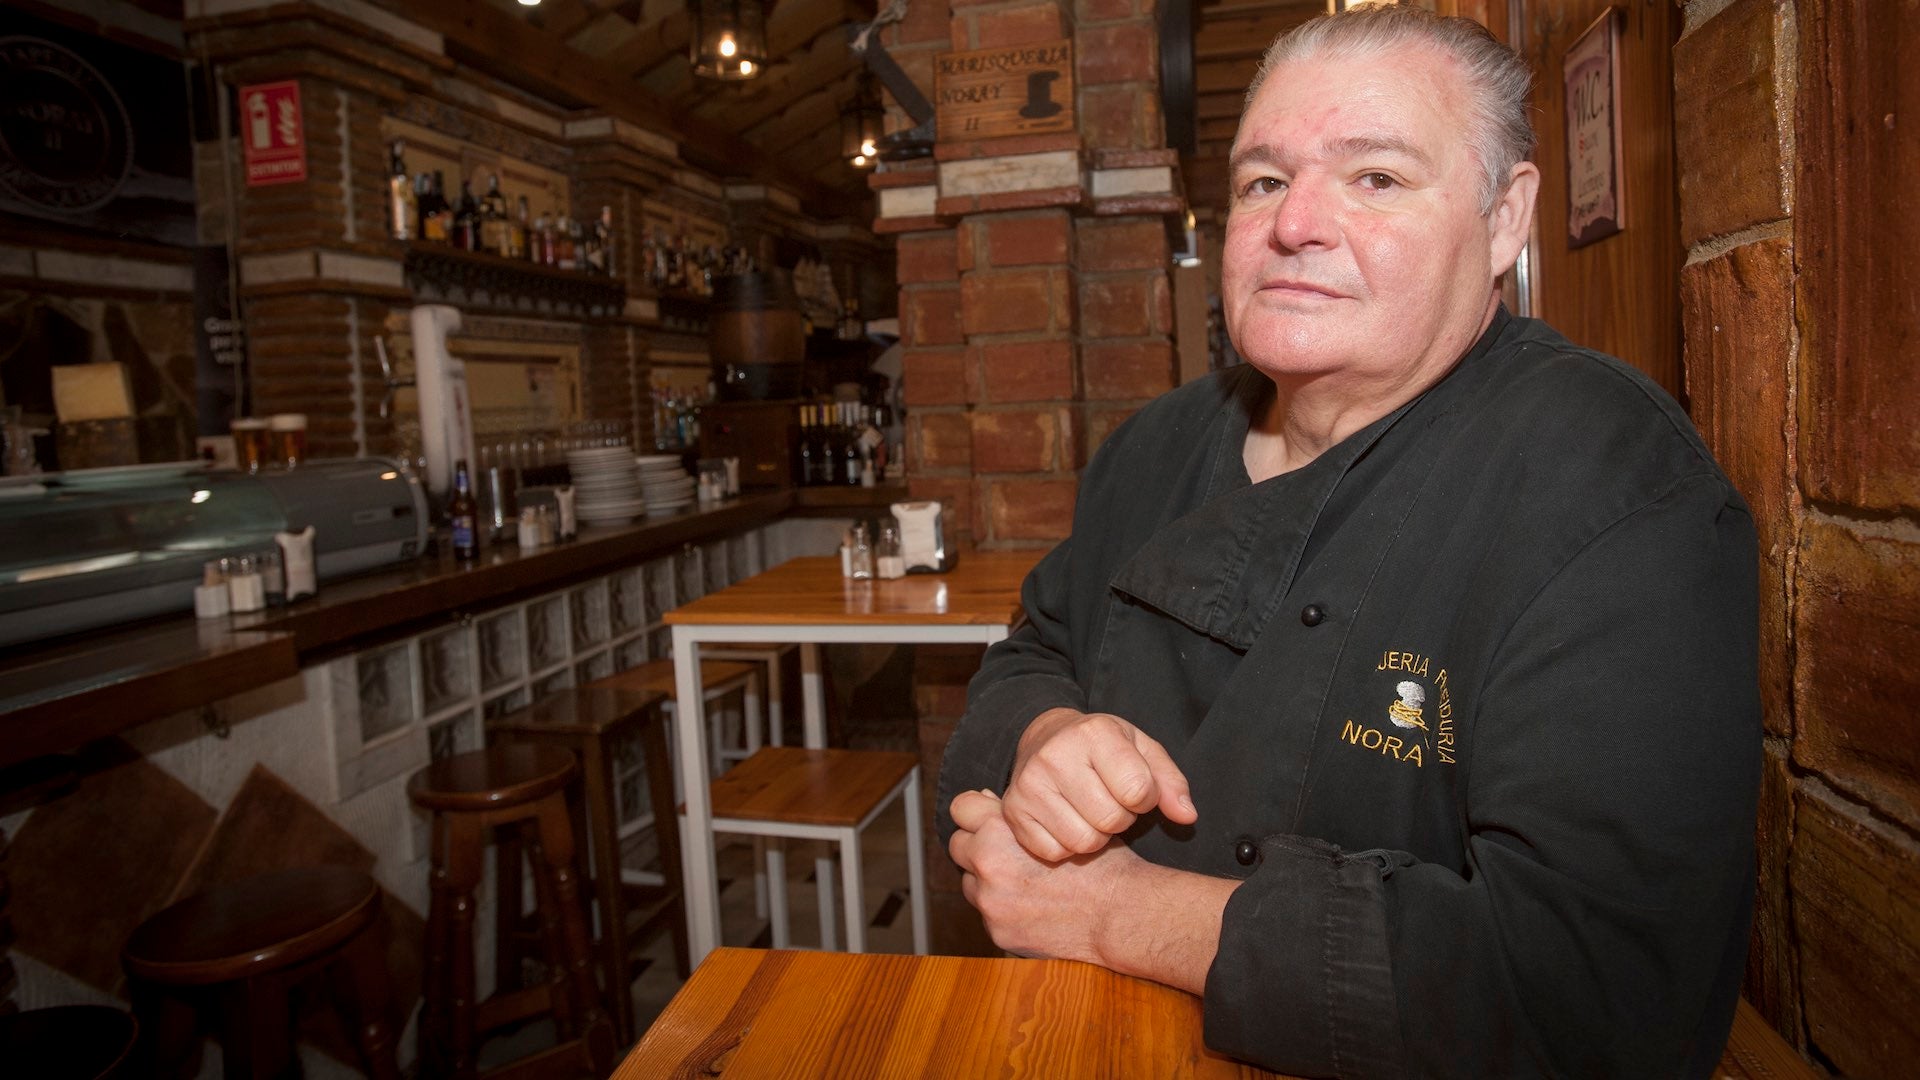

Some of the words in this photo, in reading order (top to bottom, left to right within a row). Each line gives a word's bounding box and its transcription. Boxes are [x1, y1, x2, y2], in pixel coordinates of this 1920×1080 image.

[938, 46, 1068, 74] MARISQUERIA
[941, 82, 1004, 104] NORAY
[1573, 70, 1604, 130] W.C.
